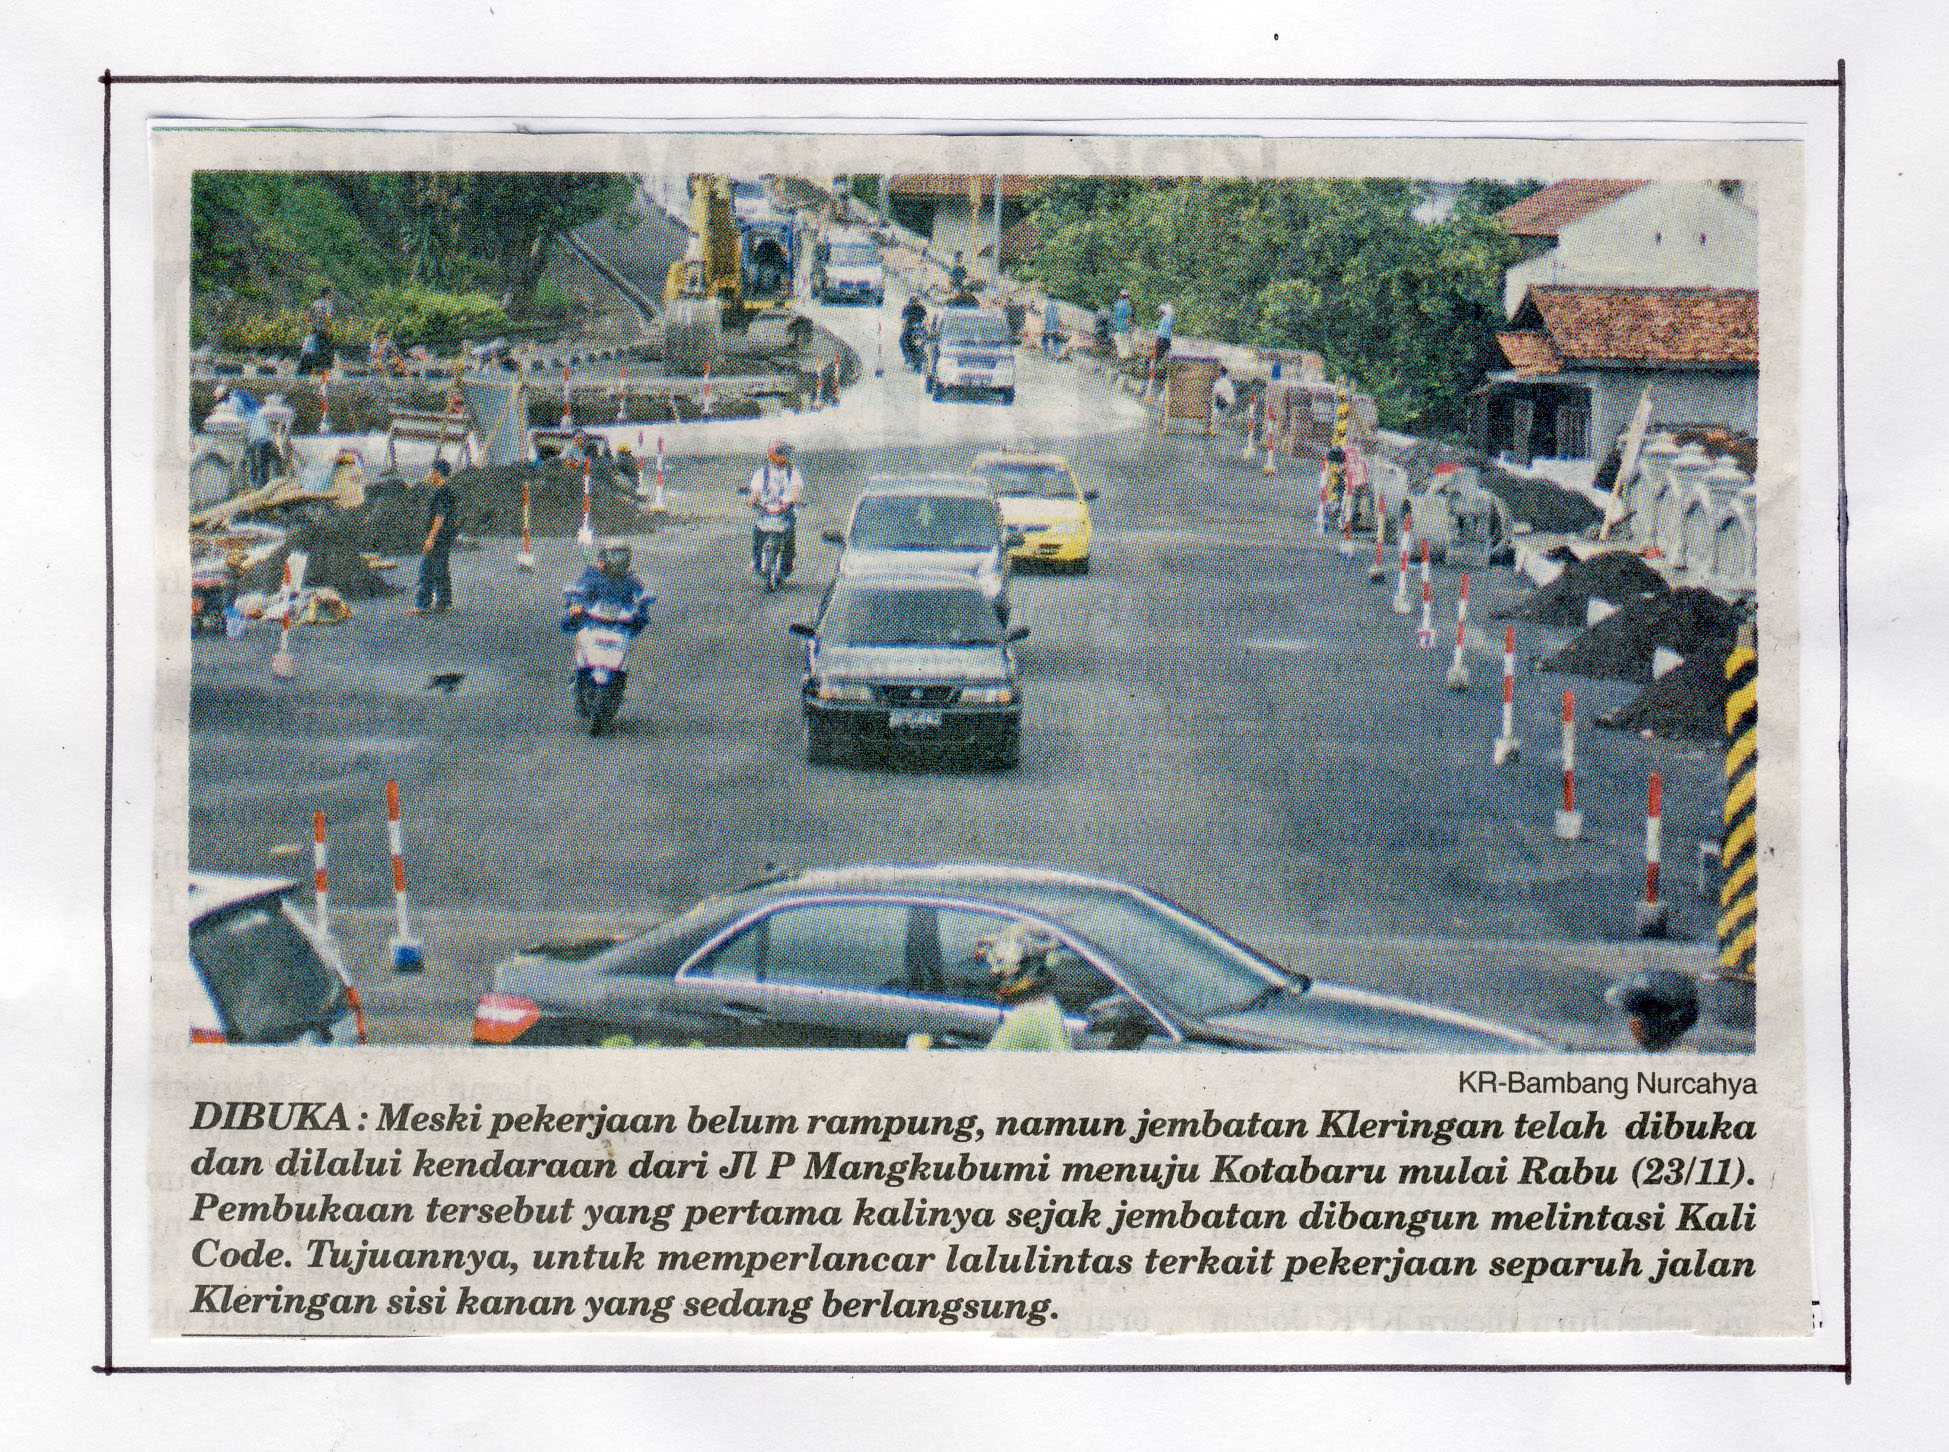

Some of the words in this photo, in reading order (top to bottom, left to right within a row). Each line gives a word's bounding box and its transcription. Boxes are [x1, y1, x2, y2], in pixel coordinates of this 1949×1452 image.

[1459, 1070, 1629, 1100] KR-Bambang
[1637, 1071, 1758, 1101] Nurcahya
[375, 1102, 483, 1132] Meski
[486, 1103, 678, 1140] pekerjaan
[687, 1104, 800, 1135] belum
[806, 1114, 985, 1143] rampung,
[995, 1116, 1127, 1137] namun
[1128, 1107, 1309, 1145] jembatan
[1315, 1109, 1505, 1146] Kleringan
[1514, 1110, 1608, 1140] telah
[1624, 1110, 1758, 1141] dibuka
[190, 1146, 265, 1176] dan
[275, 1147, 403, 1177] dilalui
[412, 1148, 618, 1179] kendaraan
[628, 1149, 709, 1180] dari
[718, 1150, 758, 1180] Jl
[765, 1151, 796, 1180] P
[802, 1151, 1051, 1188] Mangkubumi
[1061, 1153, 1201, 1190] menuju
[1209, 1154, 1388, 1185] Kotabaru
[1398, 1155, 1509, 1185] mulai
[1516, 1155, 1619, 1186] Rabu
[1631, 1156, 1755, 1190] (23/11).
[189, 1192, 415, 1223] Pembukaan
[426, 1194, 575, 1225] tersebut
[581, 1203, 676, 1232] yang
[680, 1199, 843, 1232] pertama
[852, 1197, 996, 1235] kalinya
[1005, 1198, 1102, 1235] sejak
[1105, 1199, 1288, 1236] jembatan
[1298, 1200, 1480, 1240] dibangun
[1490, 1201, 1666, 1232] melintasi
[1674, 1202, 1757, 1232] Kali
[191, 1237, 292, 1268] Code.
[306, 1238, 519, 1277] Tujuannya,
[533, 1241, 645, 1271] untuk
[657, 1242, 936, 1279] memperlancar
[945, 1243, 1134, 1275] lalulintas
[1144, 1245, 1276, 1276] terkait
[1280, 1246, 1478, 1283] pekerjaan
[1488, 1247, 1644, 1284] separuh
[1647, 1247, 1757, 1285] jalan
[189, 1284, 378, 1321] Kleringan
[386, 1285, 448, 1315] sisi
[455, 1285, 577, 1316] kanan
[582, 1295, 676, 1324] yang
[682, 1287, 814, 1325] sedang
[821, 1288, 1058, 1327] berlangsung.
